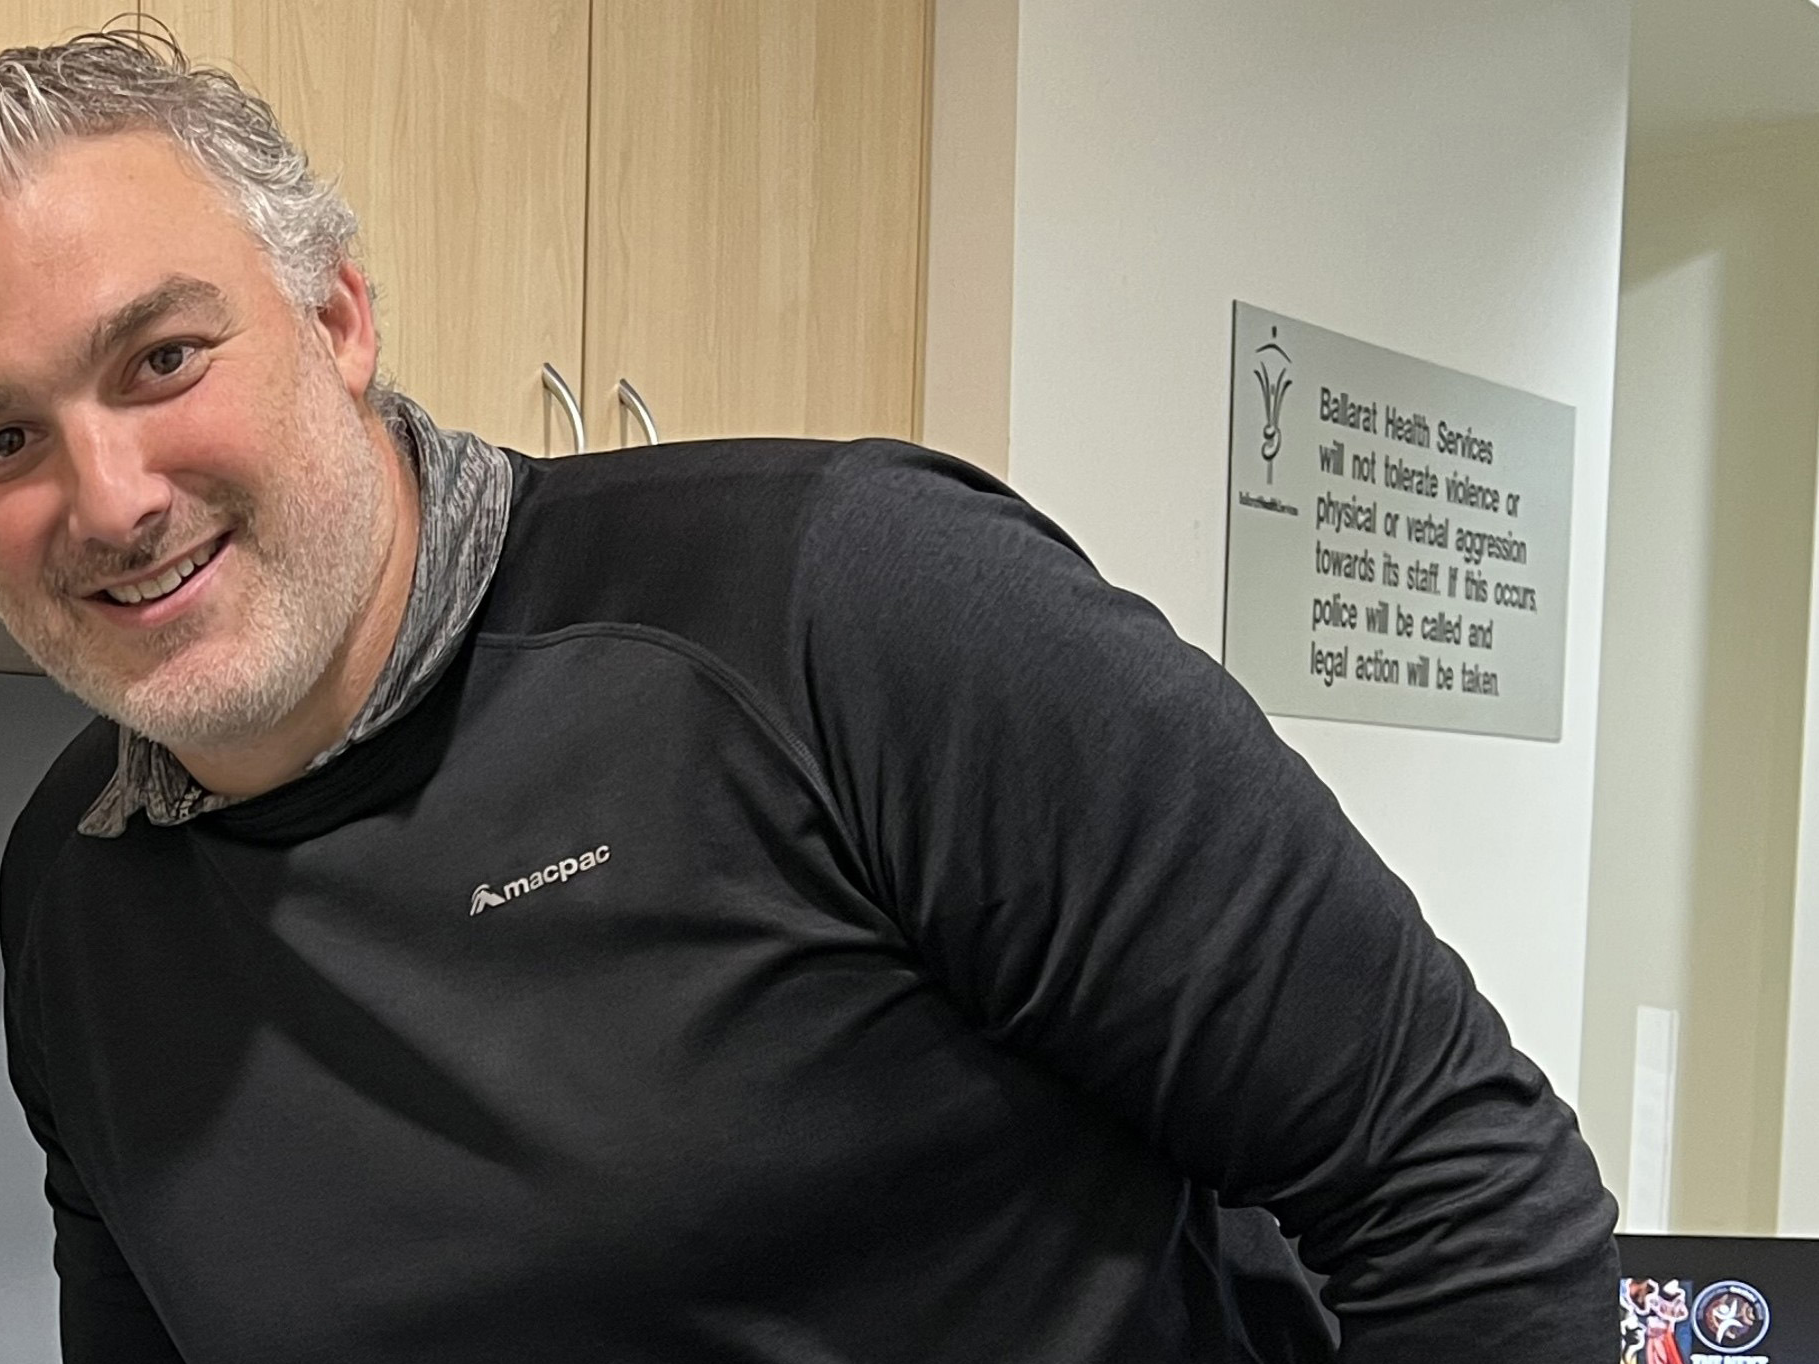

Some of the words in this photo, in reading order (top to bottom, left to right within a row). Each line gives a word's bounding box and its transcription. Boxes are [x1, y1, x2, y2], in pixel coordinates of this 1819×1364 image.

[1319, 386, 1378, 435] Ballarat
[1384, 404, 1431, 449] Health
[1436, 420, 1494, 465] Services
[1318, 439, 1345, 477] will
[1352, 450, 1377, 485] not
[1384, 454, 1439, 498] tolerate
[1445, 469, 1500, 513] violence
[1505, 492, 1520, 518] or
[1316, 491, 1377, 534] physical
[1384, 511, 1400, 539] or
[1406, 513, 1449, 549] verbal
[1455, 530, 1527, 566] aggression
[1315, 540, 1376, 583] towards
[1382, 550, 1400, 588] its
[1447, 565, 1459, 598] If
[1464, 569, 1488, 604] this
[1312, 592, 1358, 632] police
[1365, 600, 1390, 635] will
[1396, 604, 1414, 638] be
[1421, 611, 1463, 645] called
[1468, 618, 1494, 650] and
[1310, 640, 1349, 687] legal
[1355, 648, 1400, 685] action
[1406, 654, 1430, 688] will
[1436, 657, 1454, 690] be
[503, 844, 611, 901] macpac
